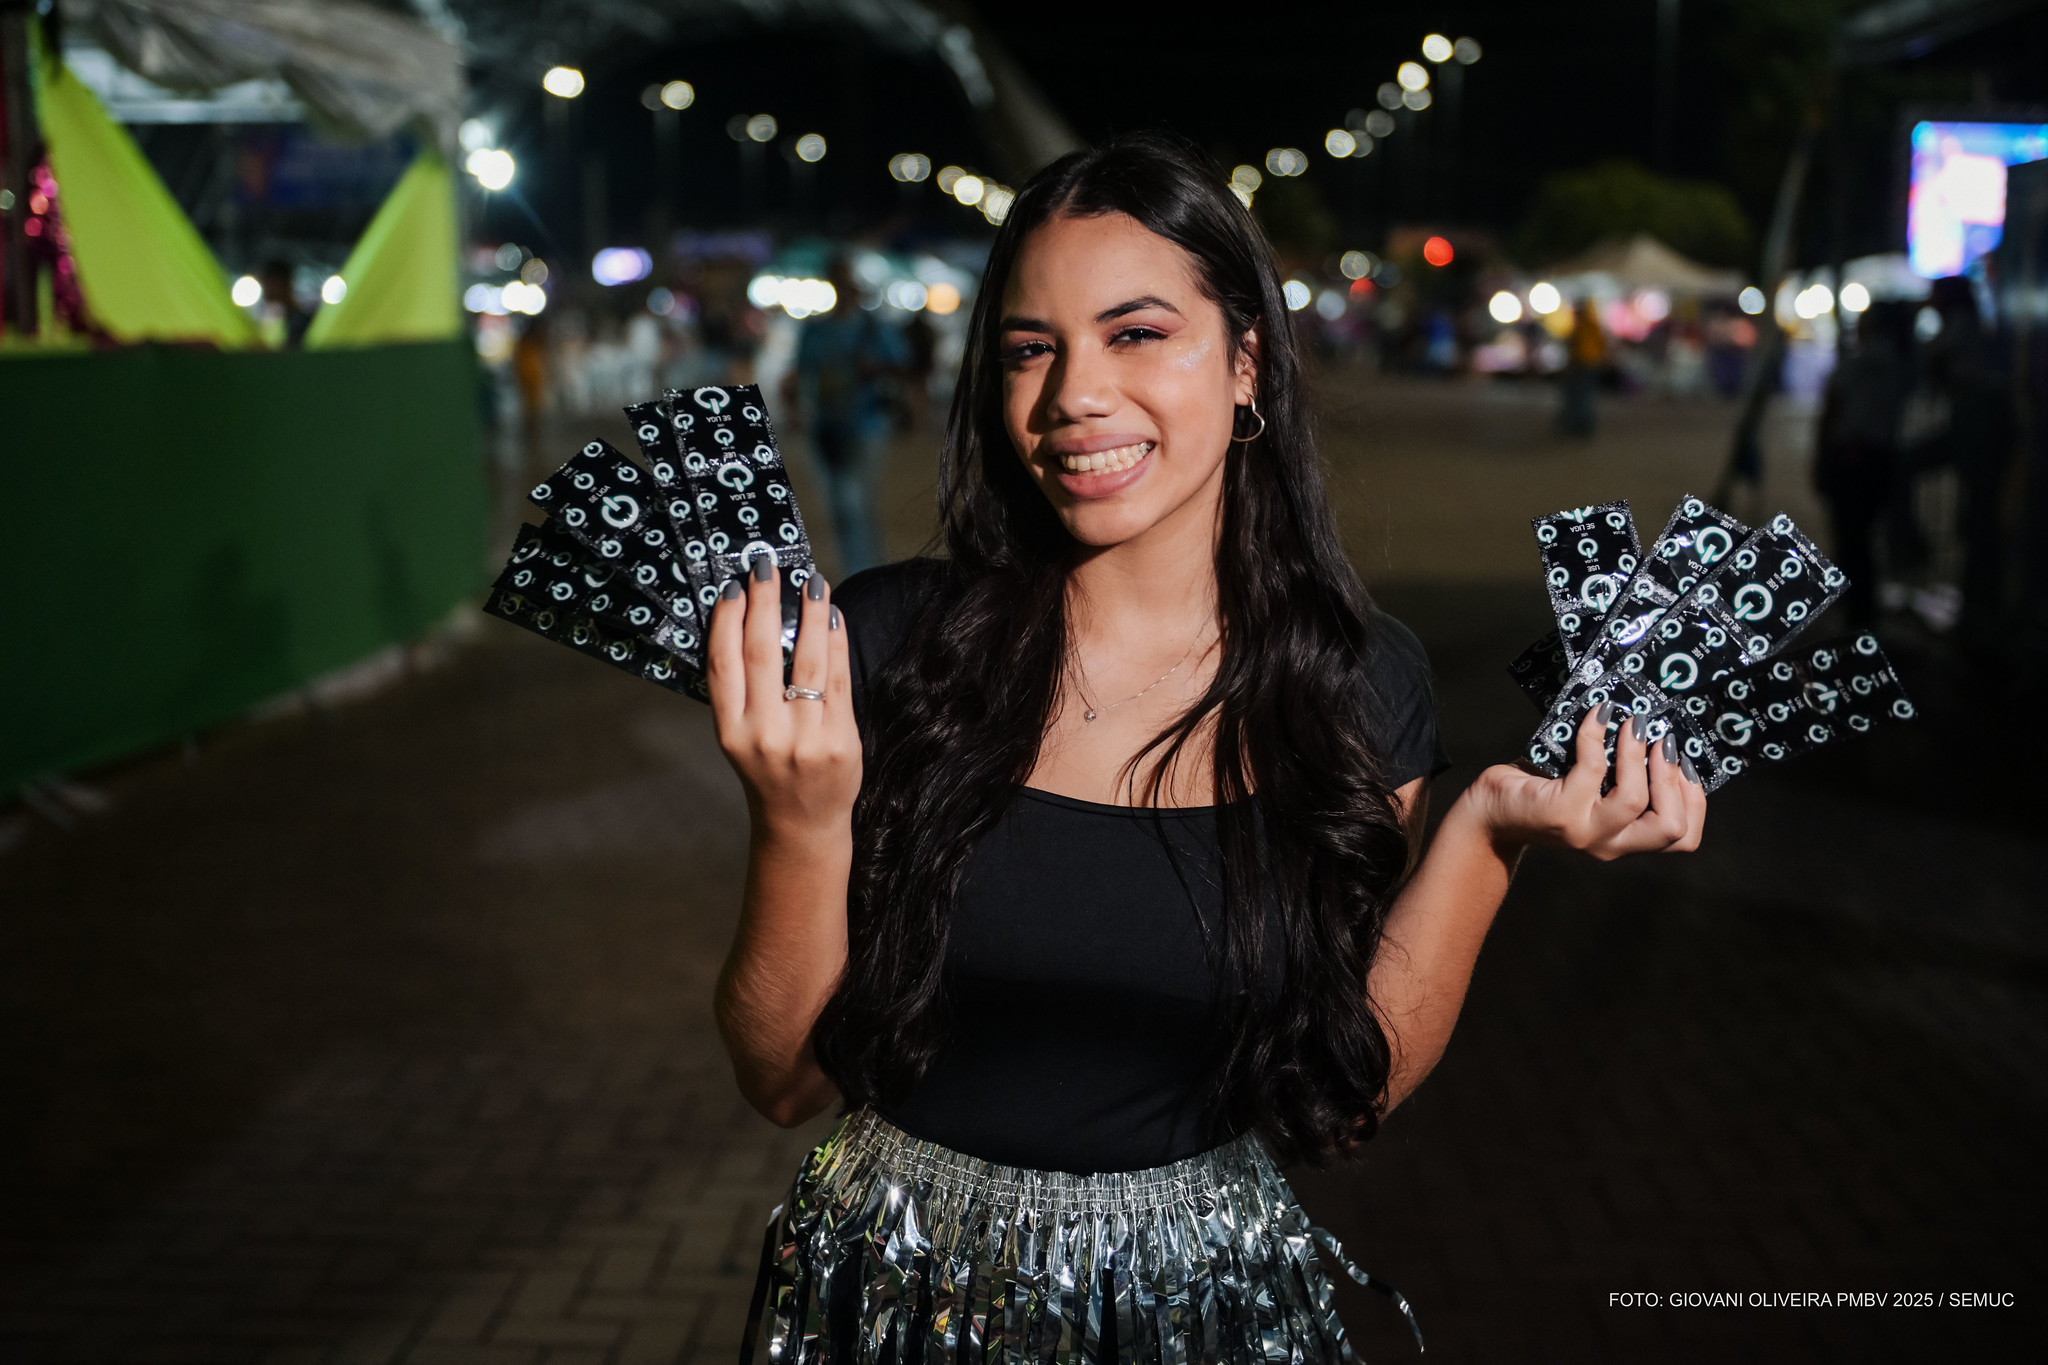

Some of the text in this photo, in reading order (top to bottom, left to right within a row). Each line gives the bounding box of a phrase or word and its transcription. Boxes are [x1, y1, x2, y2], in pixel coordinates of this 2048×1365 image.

[1569, 522, 1596, 533] SE LIGA
[1719, 519, 1733, 530] USE
[1687, 559, 1703, 572] LIGA
[1808, 554, 1818, 564] SE
[1586, 564, 1601, 573] USE
[1765, 577, 1780, 591] USE
[1720, 610, 1742, 634] SE LIGA
[1691, 646, 1705, 660] USE
[1646, 679, 1668, 702] SE LIGA
[1749, 707, 1768, 732] SE LIGA
[1707, 729, 1719, 743] USE
